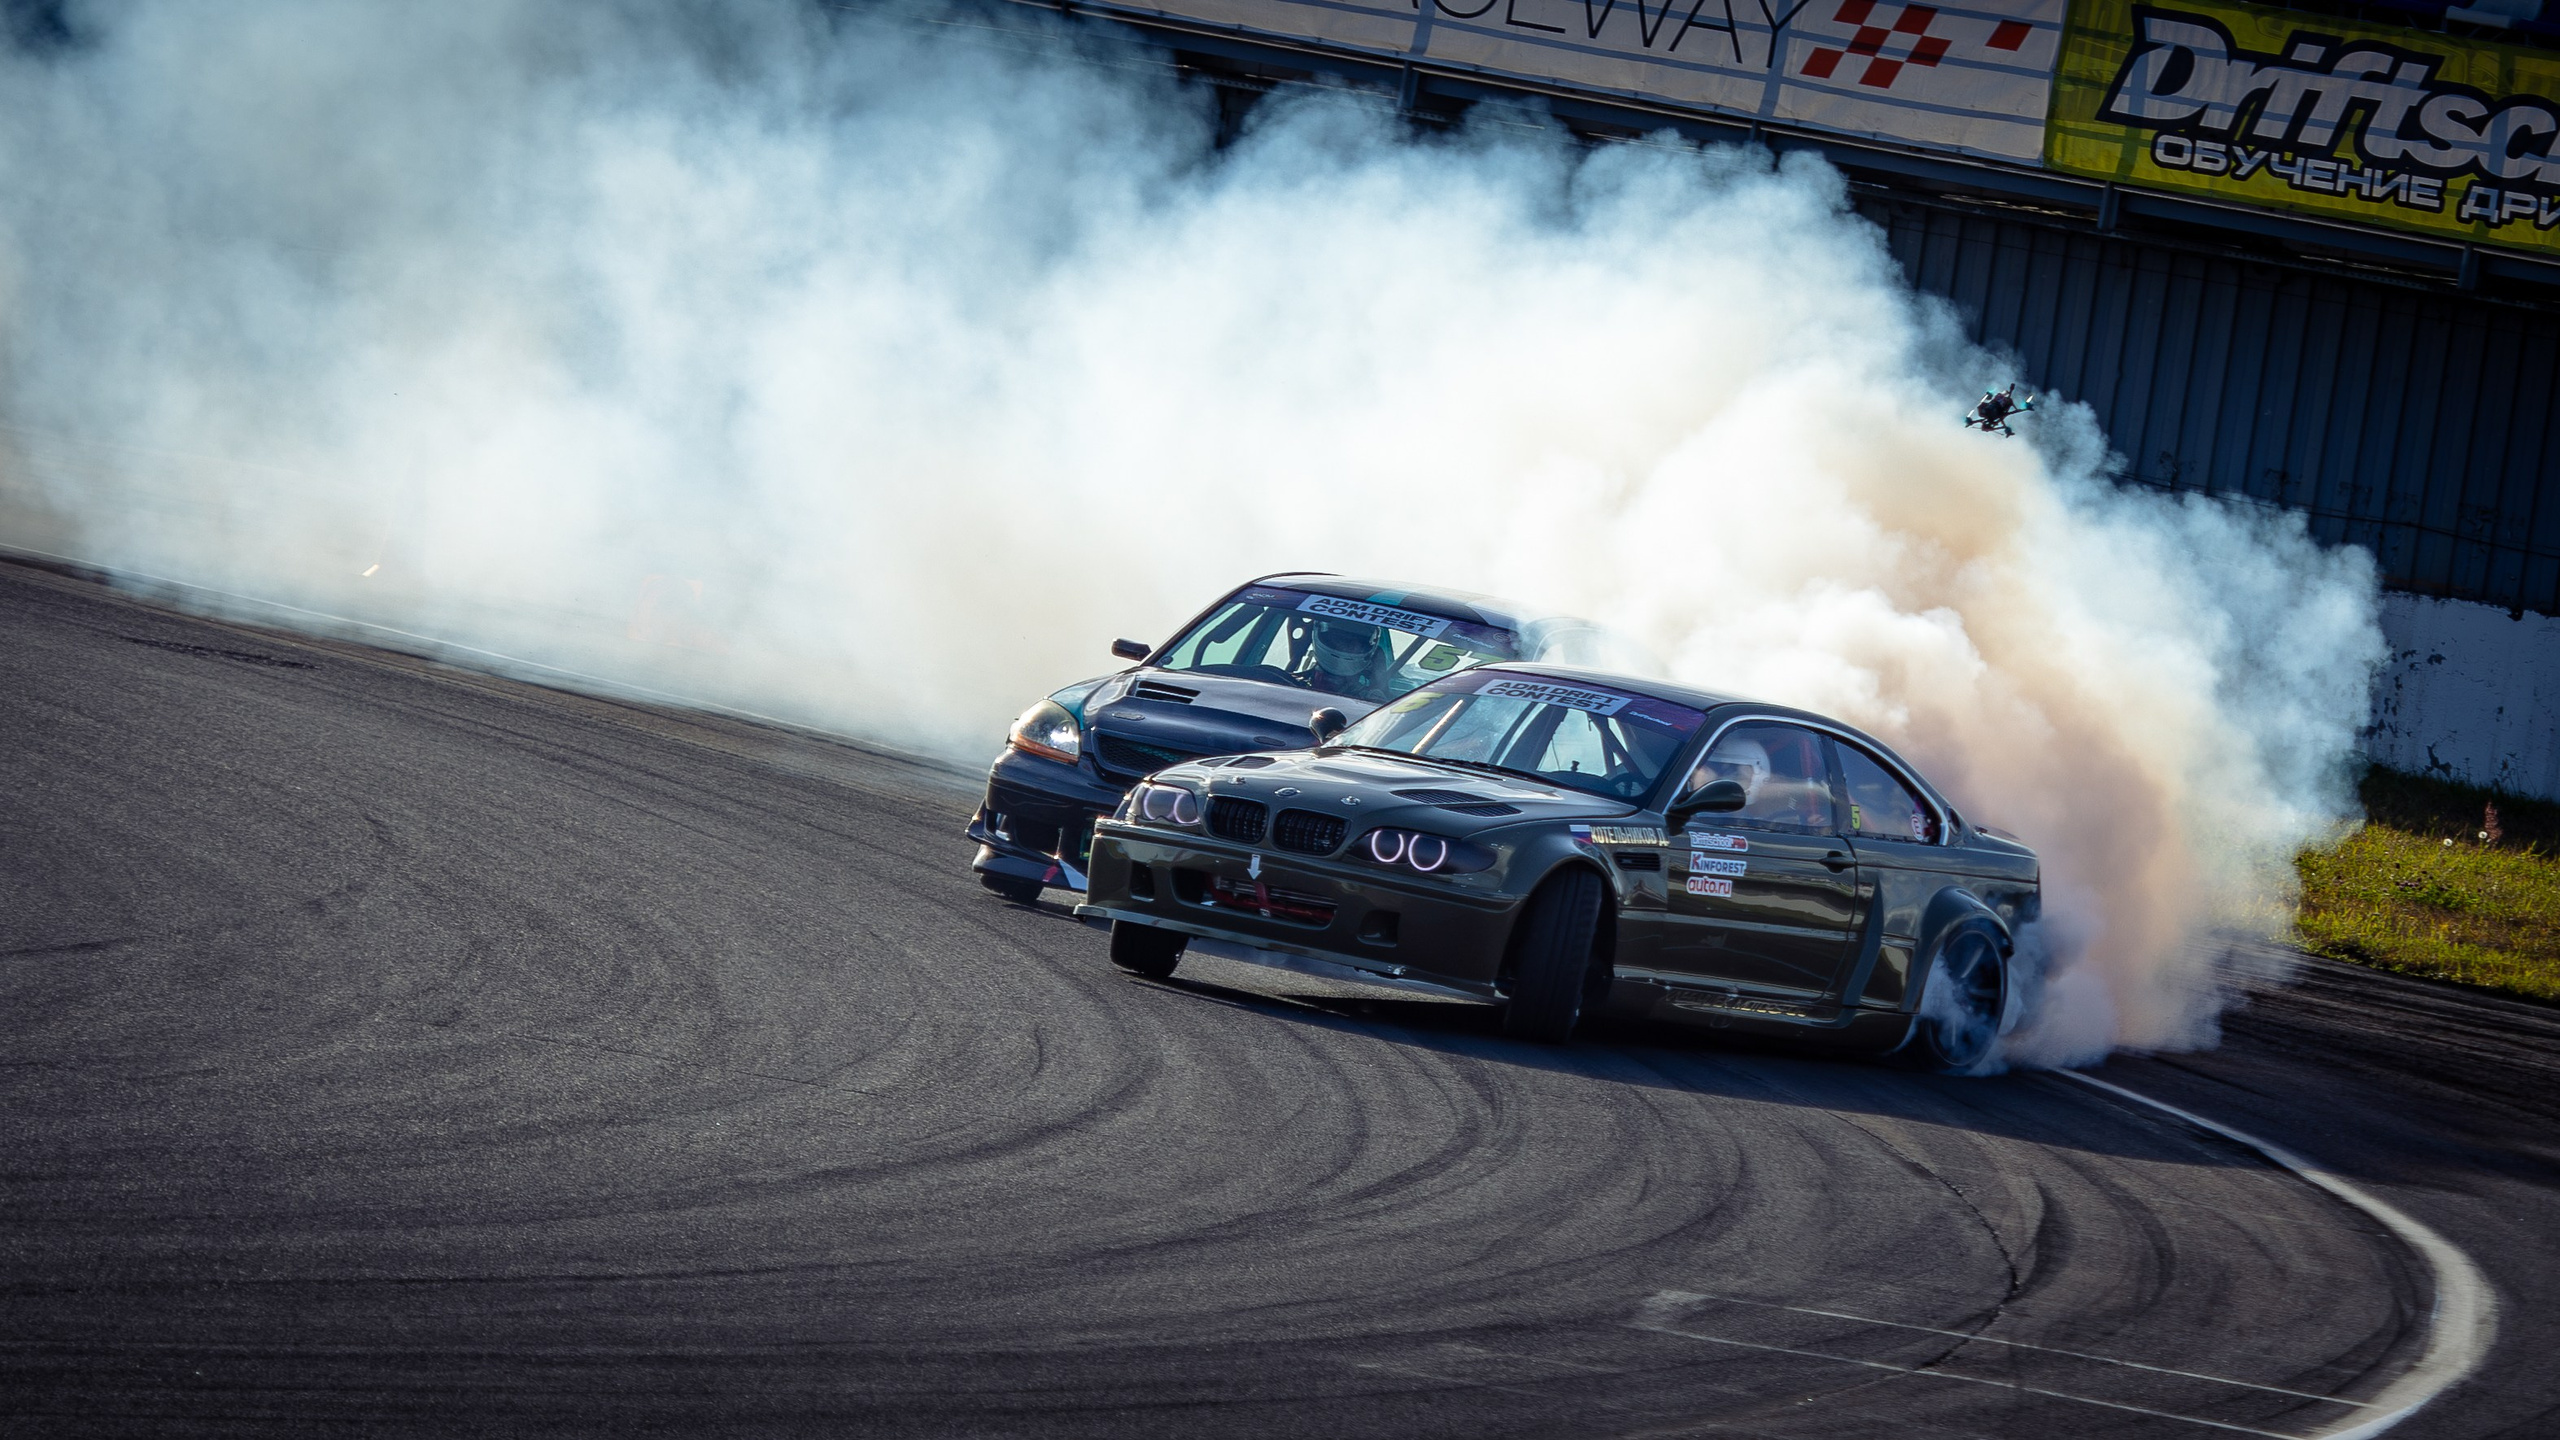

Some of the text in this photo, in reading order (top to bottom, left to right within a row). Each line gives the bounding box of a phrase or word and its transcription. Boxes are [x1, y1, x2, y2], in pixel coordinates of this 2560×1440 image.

[2154, 134, 2444, 208] ОБУЧЕНИЕ
[1308, 604, 1435, 633] CONTEST
[1315, 598, 1441, 626] ADM DRIFT
[1486, 687, 1613, 711] CONTEST
[1495, 681, 1620, 704] ADM DRIFT
[1850, 805, 1861, 830] 5
[1590, 826, 1657, 844] КОТЕЛЬНИКОВ
[1691, 853, 1745, 875] KINFOREST
[1688, 878, 1732, 896] auto.ru
